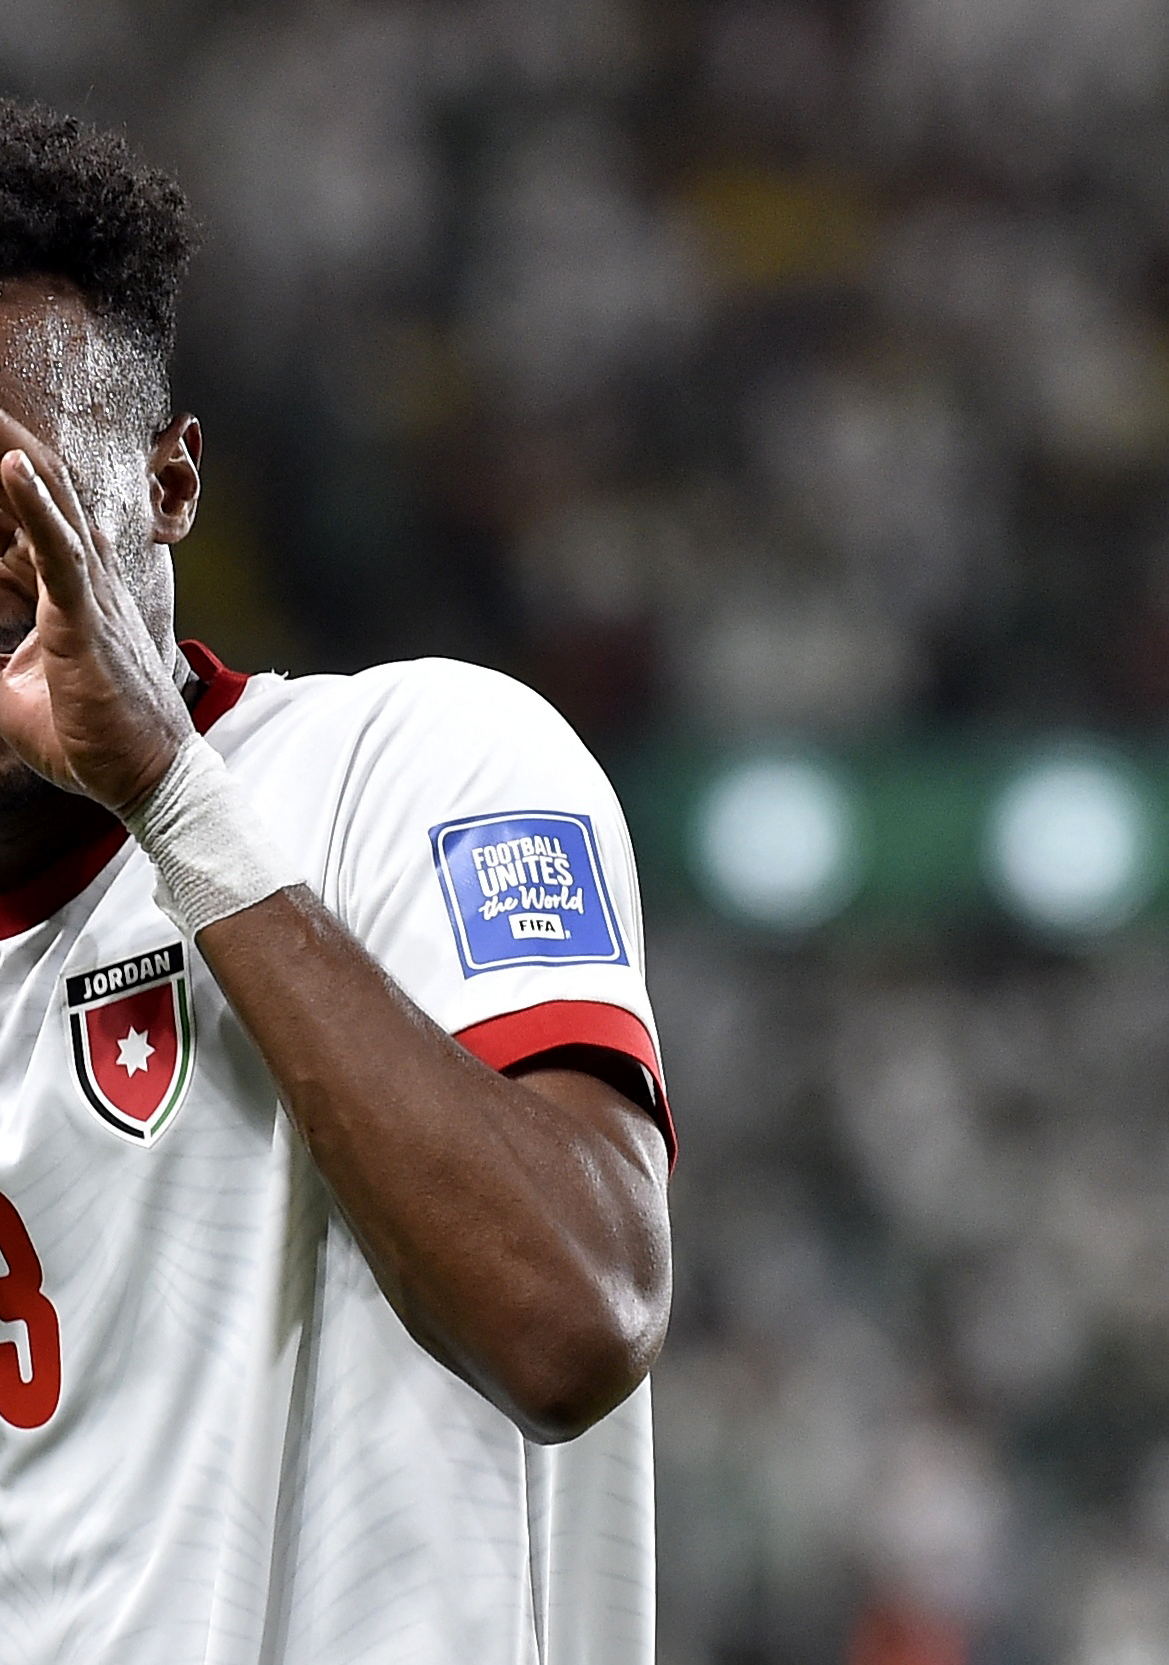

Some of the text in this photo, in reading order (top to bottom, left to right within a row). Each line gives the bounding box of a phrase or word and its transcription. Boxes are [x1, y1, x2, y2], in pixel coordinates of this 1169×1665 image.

[471, 835, 567, 871] FOOTBALL
[477, 855, 574, 898] UNITES
[478, 886, 584, 920] the World
[519, 919, 556, 932] FIFA
[83, 951, 171, 1000] JORDAN
